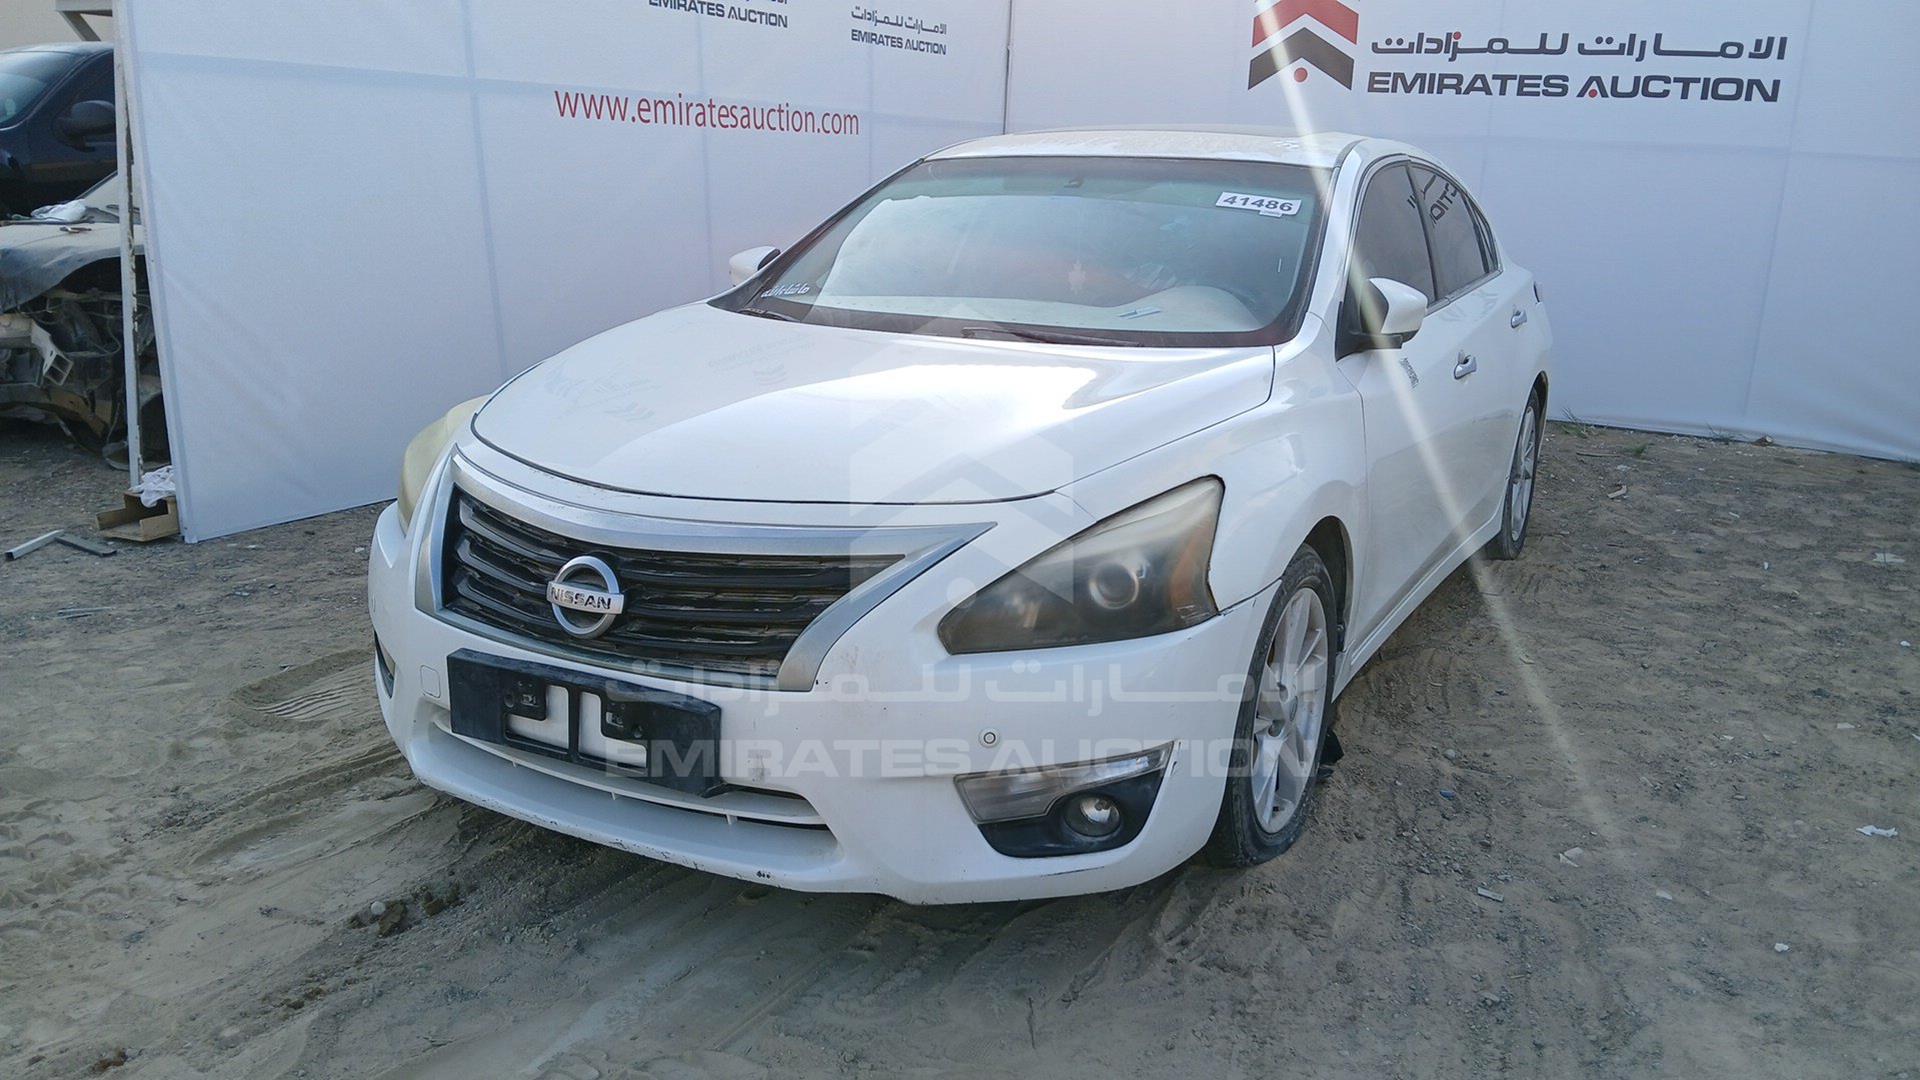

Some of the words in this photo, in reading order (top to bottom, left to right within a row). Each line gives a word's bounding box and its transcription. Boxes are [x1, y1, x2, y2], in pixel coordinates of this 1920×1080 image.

[727, 6, 788, 28] AUCTION
[851, 28, 904, 49] EMIRATES
[904, 38, 947, 55] AUCTION
[1371, 32, 1569, 62] للمزادات
[1577, 33, 1788, 62] الامارات
[1367, 72, 1570, 97] EMIRATES
[1575, 75, 1781, 102] AUCTION
[554, 90, 860, 135] www.emiratesauction.com
[1223, 195, 1294, 212] 41486
[550, 587, 612, 610] NISSAN
